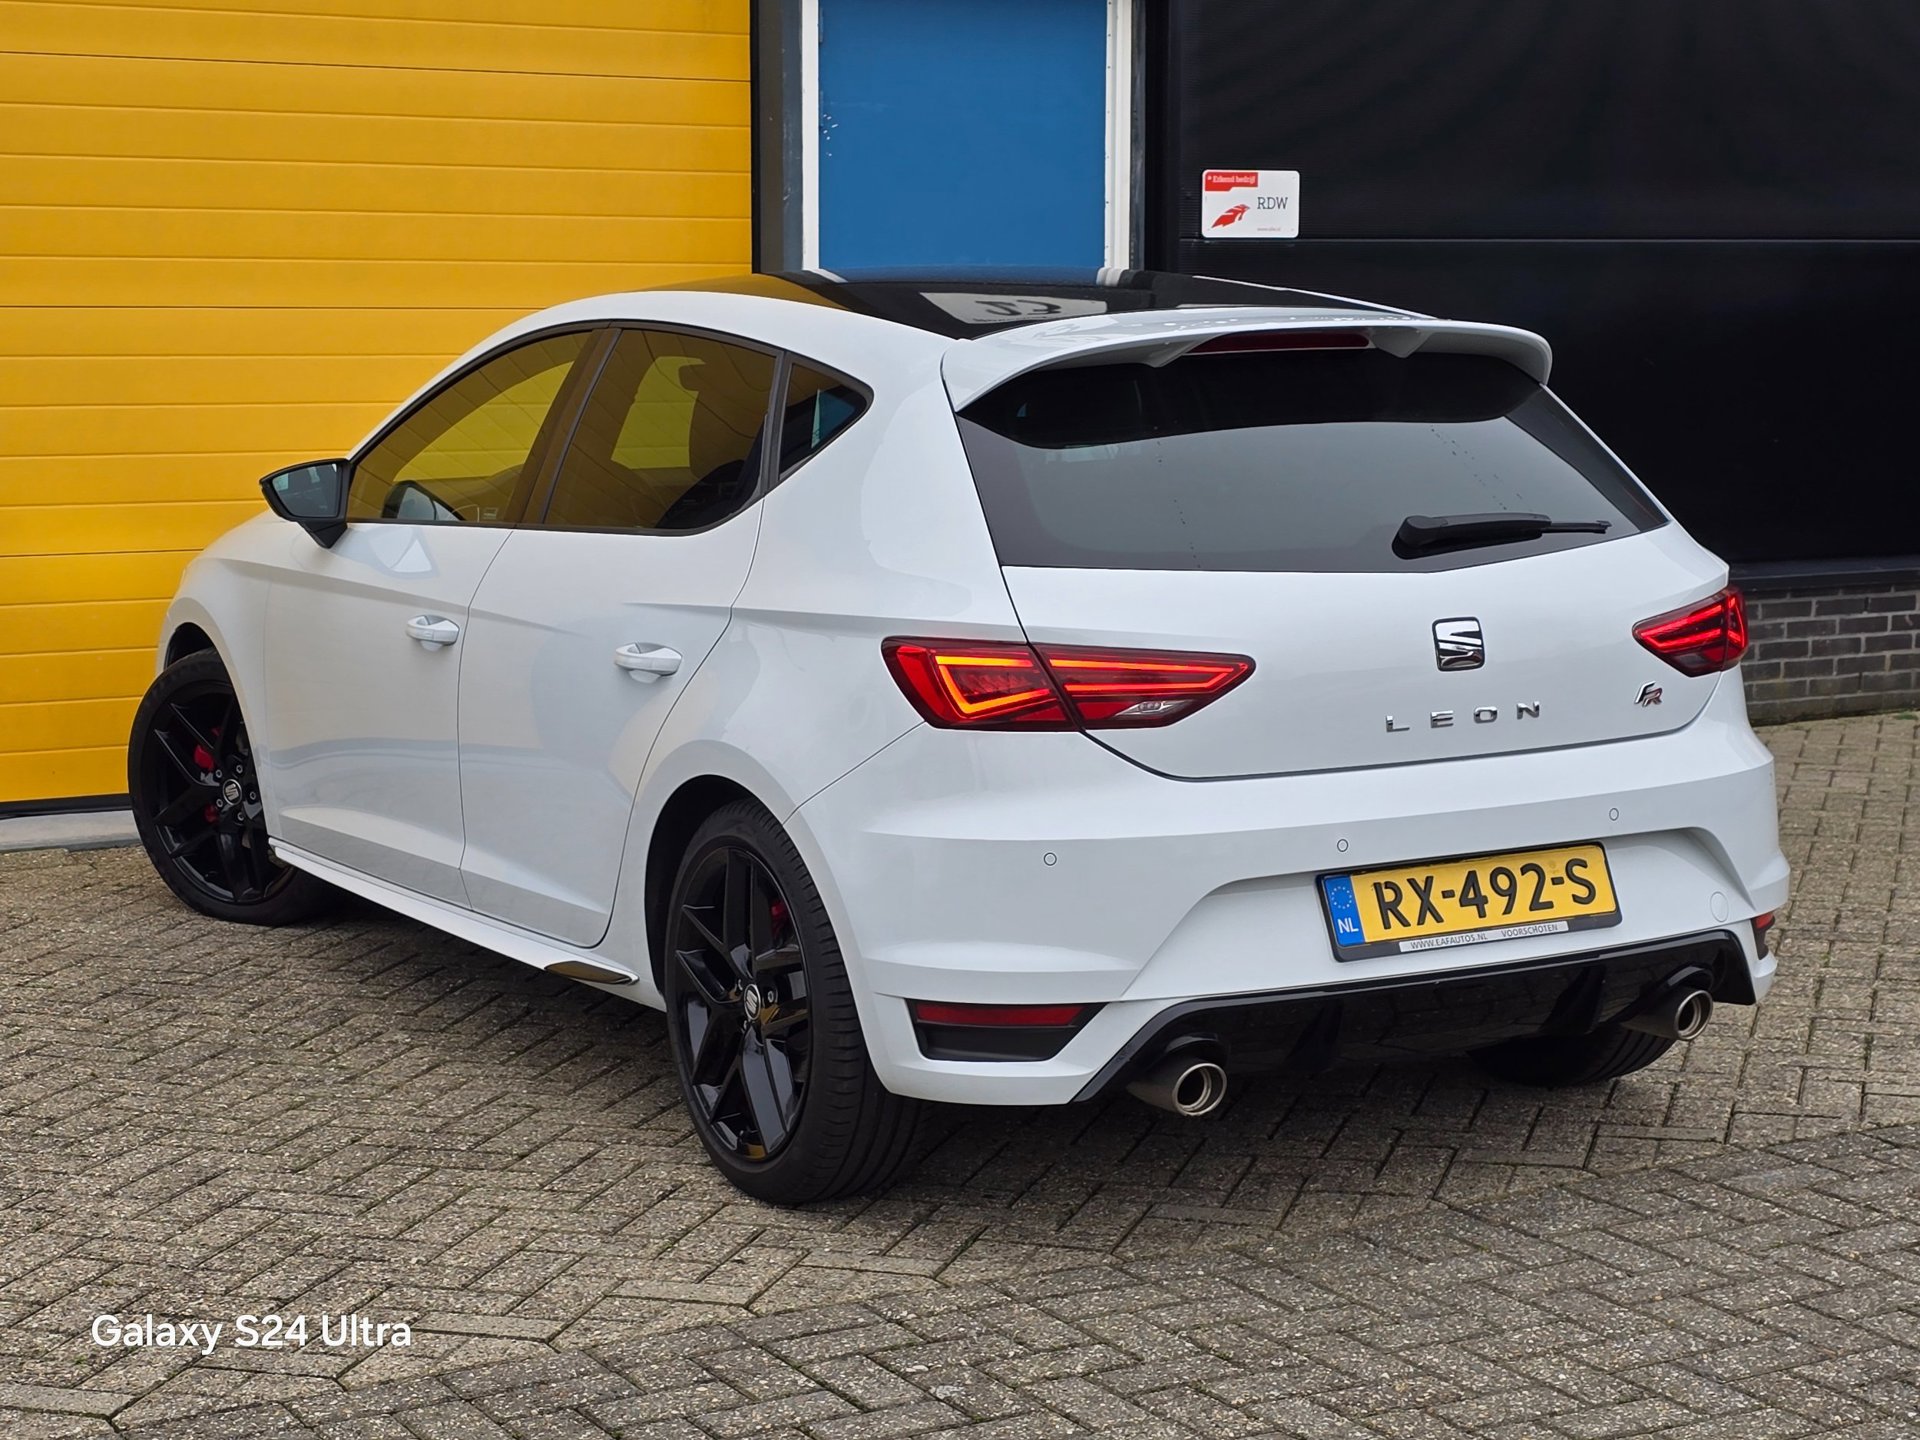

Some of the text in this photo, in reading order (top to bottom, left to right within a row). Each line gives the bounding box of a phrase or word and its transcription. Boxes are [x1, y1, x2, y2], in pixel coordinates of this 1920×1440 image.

[1257, 196, 1289, 210] RDW
[1385, 700, 1541, 732] LEON
[1373, 858, 1597, 930] RX-492-S
[1337, 917, 1359, 934] NL
[1501, 924, 1558, 938] VOORSCHOTEN
